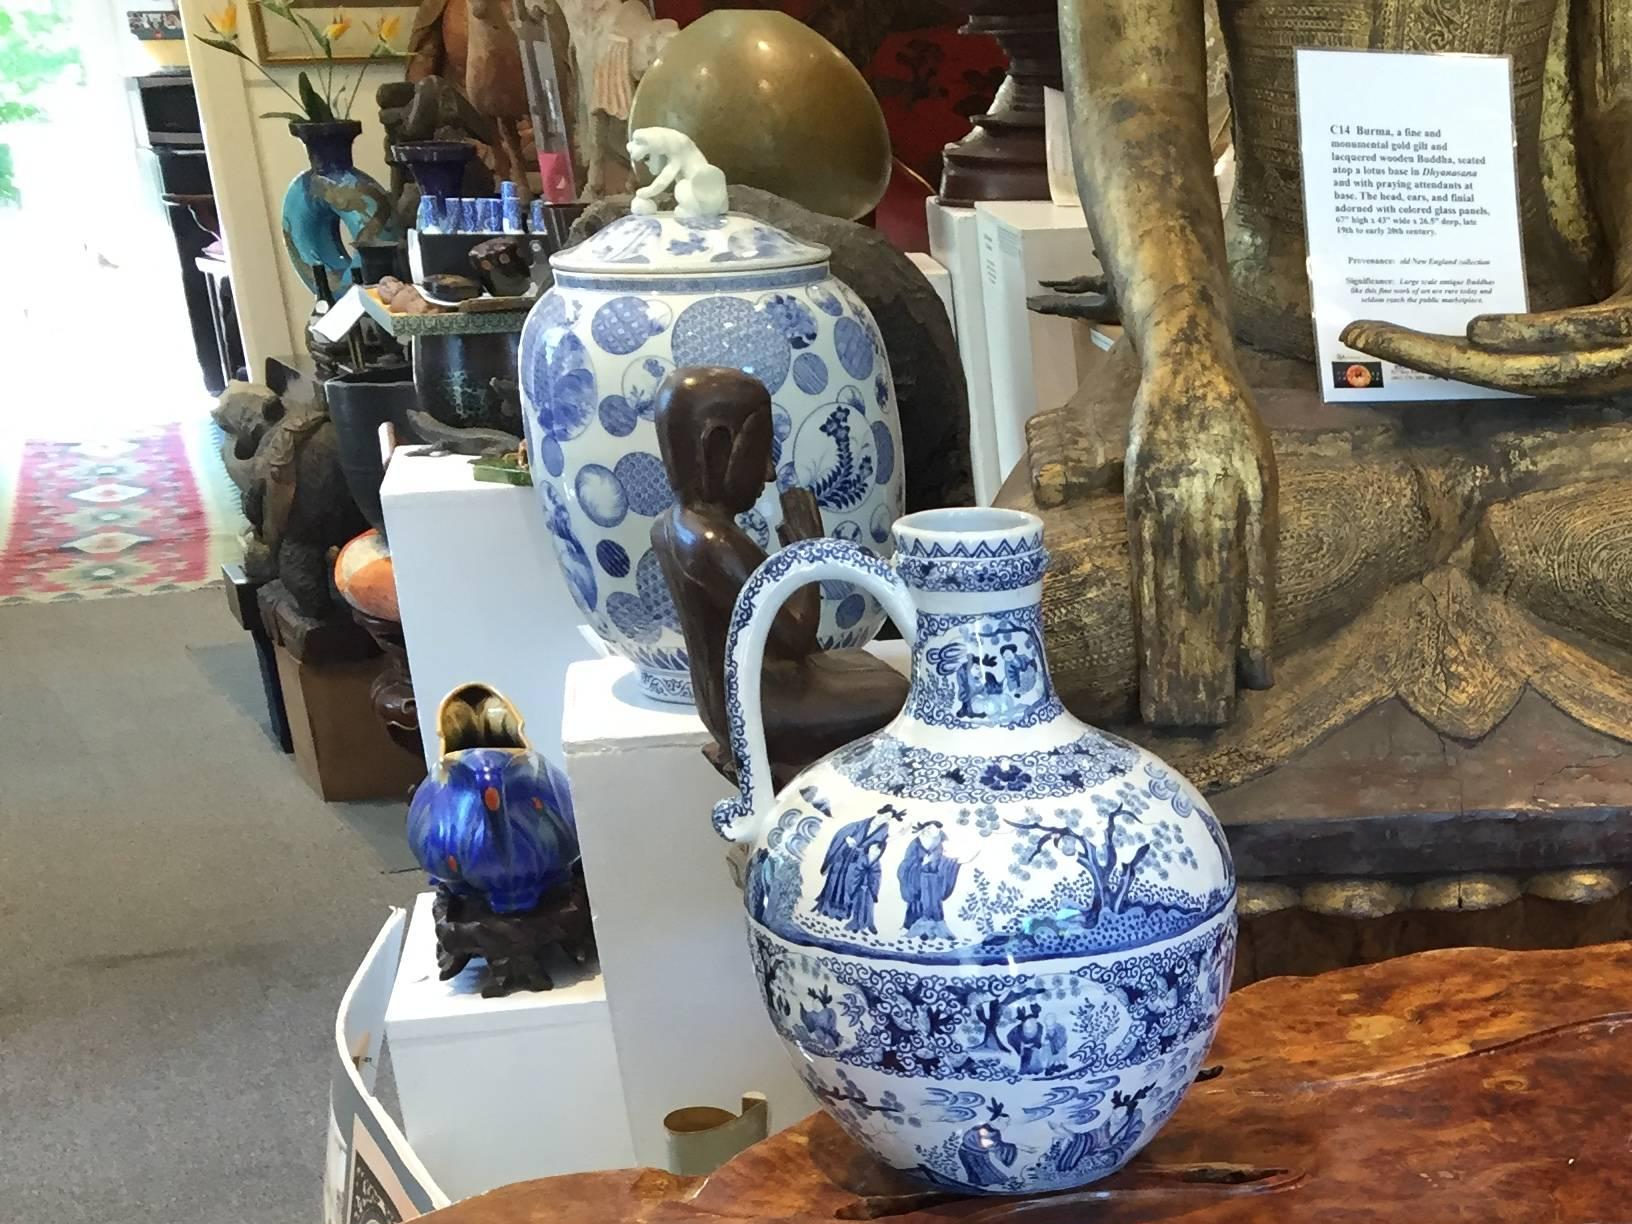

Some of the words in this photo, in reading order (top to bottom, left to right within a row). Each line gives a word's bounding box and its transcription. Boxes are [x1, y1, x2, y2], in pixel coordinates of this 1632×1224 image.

[1330, 125, 1350, 135] C14
[1357, 126, 1394, 136] Burma,
[1405, 128, 1422, 137] fine
[1425, 129, 1441, 138] and
[1331, 140, 1388, 149] monumental
[1391, 141, 1410, 151] gold
[1414, 142, 1428, 152] gilt
[1431, 142, 1447, 150] and
[1331, 152, 1376, 163] lacquered
[1380, 154, 1414, 163] wooden
[1417, 155, 1455, 164] Buddha,
[1458, 156, 1486, 164] seated
[1333, 166, 1352, 175] atop
[1364, 166, 1385, 175] lotus
[1388, 167, 1408, 175] base
[1411, 167, 1420, 175] in
[1333, 179, 1350, 187] and
[1377, 181, 1412, 190] praying
[1415, 181, 1461, 189] attendants
[1465, 182, 1473, 190] at
[1334, 191, 1357, 200] base.
[1360, 192, 1377, 200] The
[1380, 192, 1404, 201] head,
[1407, 194, 1429, 202] ears,
[1432, 194, 1448, 202] and
[1451, 194, 1474, 202] finial
[1335, 204, 1373, 212] adorned
[1377, 205, 1395, 213] with
[1399, 206, 1431, 214] colored
[1435, 207, 1456, 216] glass
[1459, 207, 1490, 216] panels,
[1352, 216, 1368, 224] high
[1337, 226, 1353, 234] 19th
[1366, 227, 1384, 235] early
[1429, 258, 1456, 266] England
